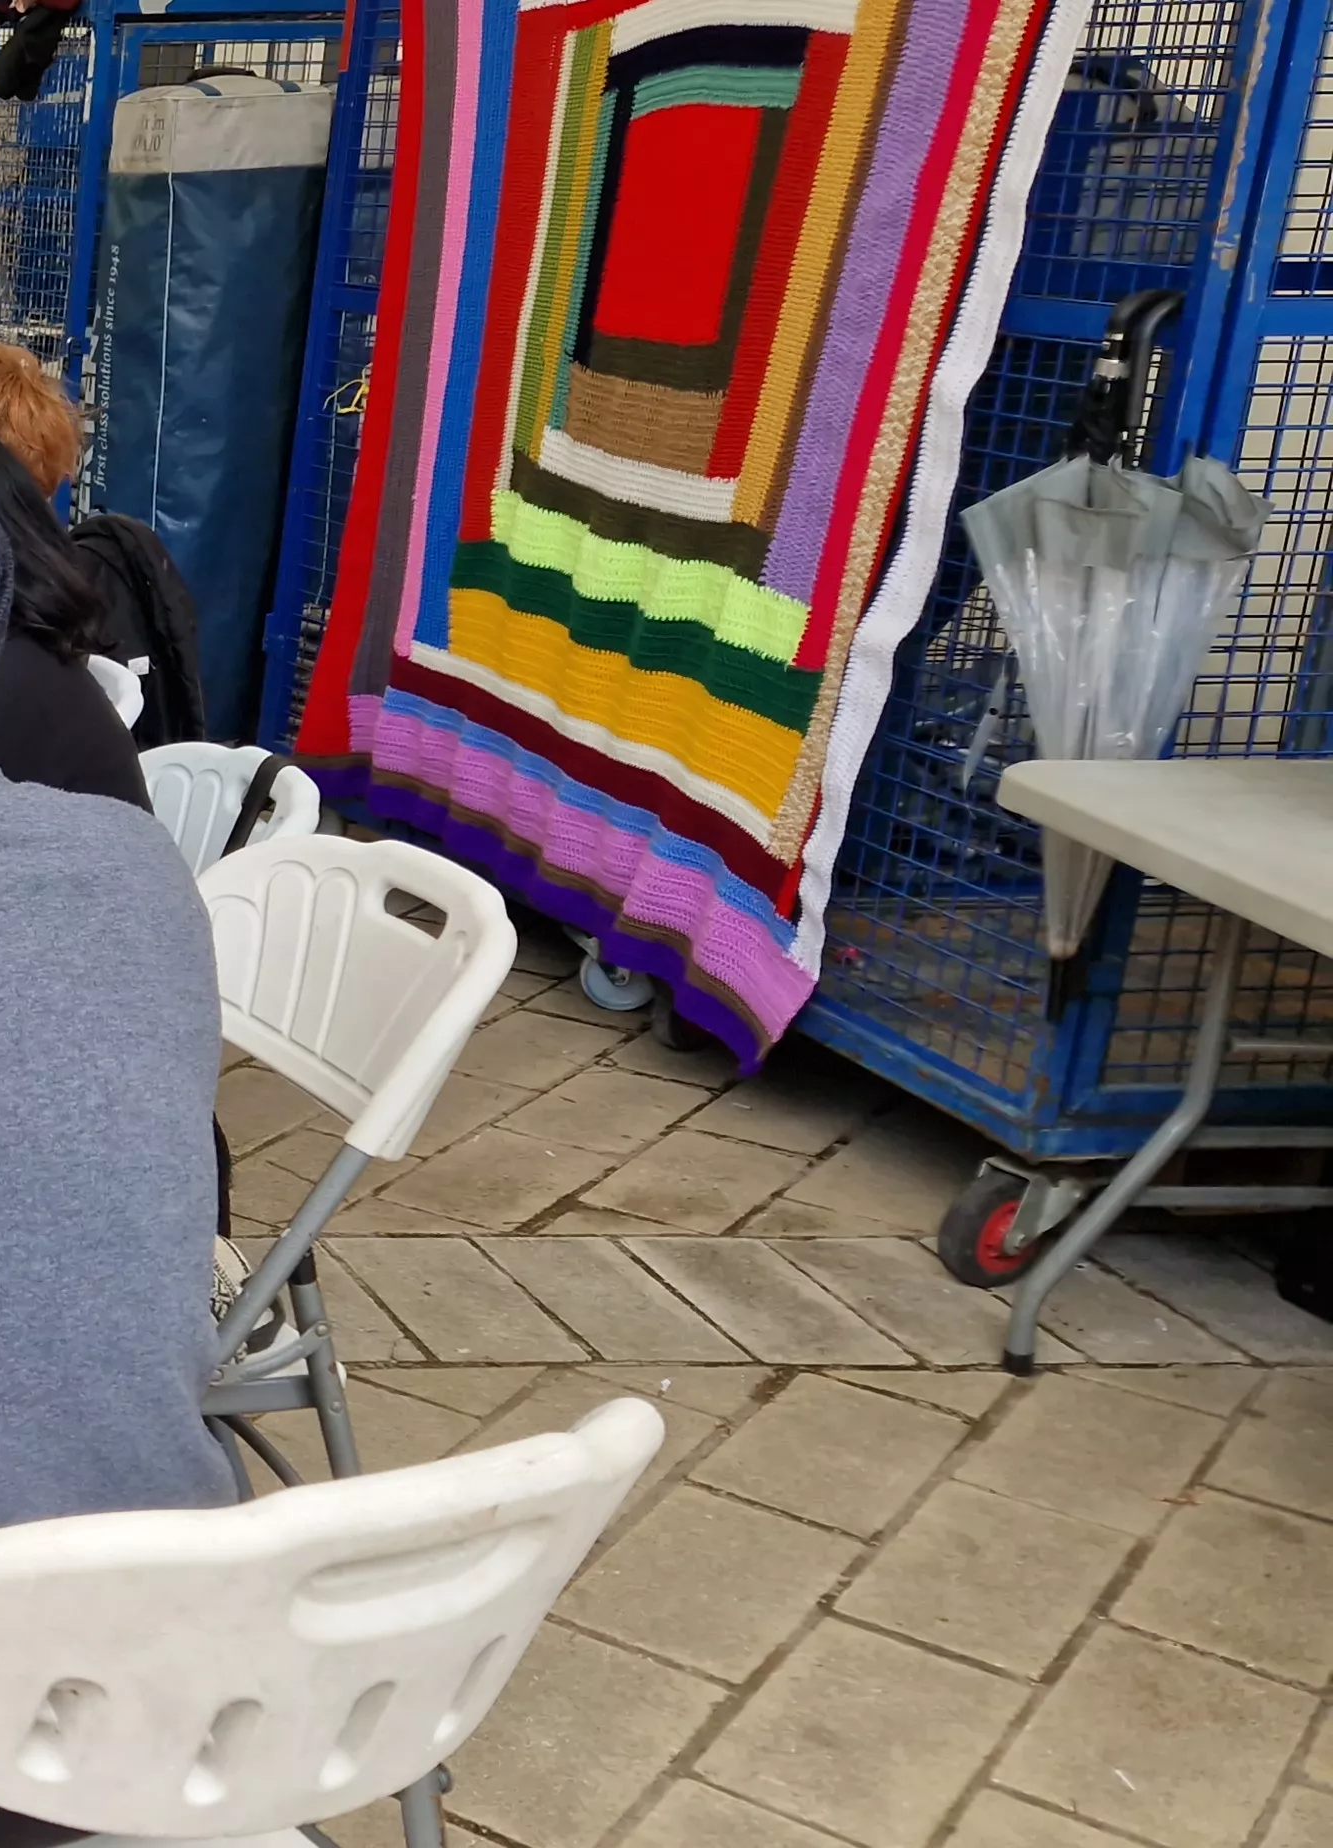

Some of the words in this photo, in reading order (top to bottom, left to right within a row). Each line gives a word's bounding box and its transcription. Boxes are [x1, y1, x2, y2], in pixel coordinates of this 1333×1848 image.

[110, 245, 121, 285] 1948
[104, 288, 116, 331] since
[98, 333, 113, 409] solutions
[97, 411, 109, 450] class
[93, 456, 107, 492] first
